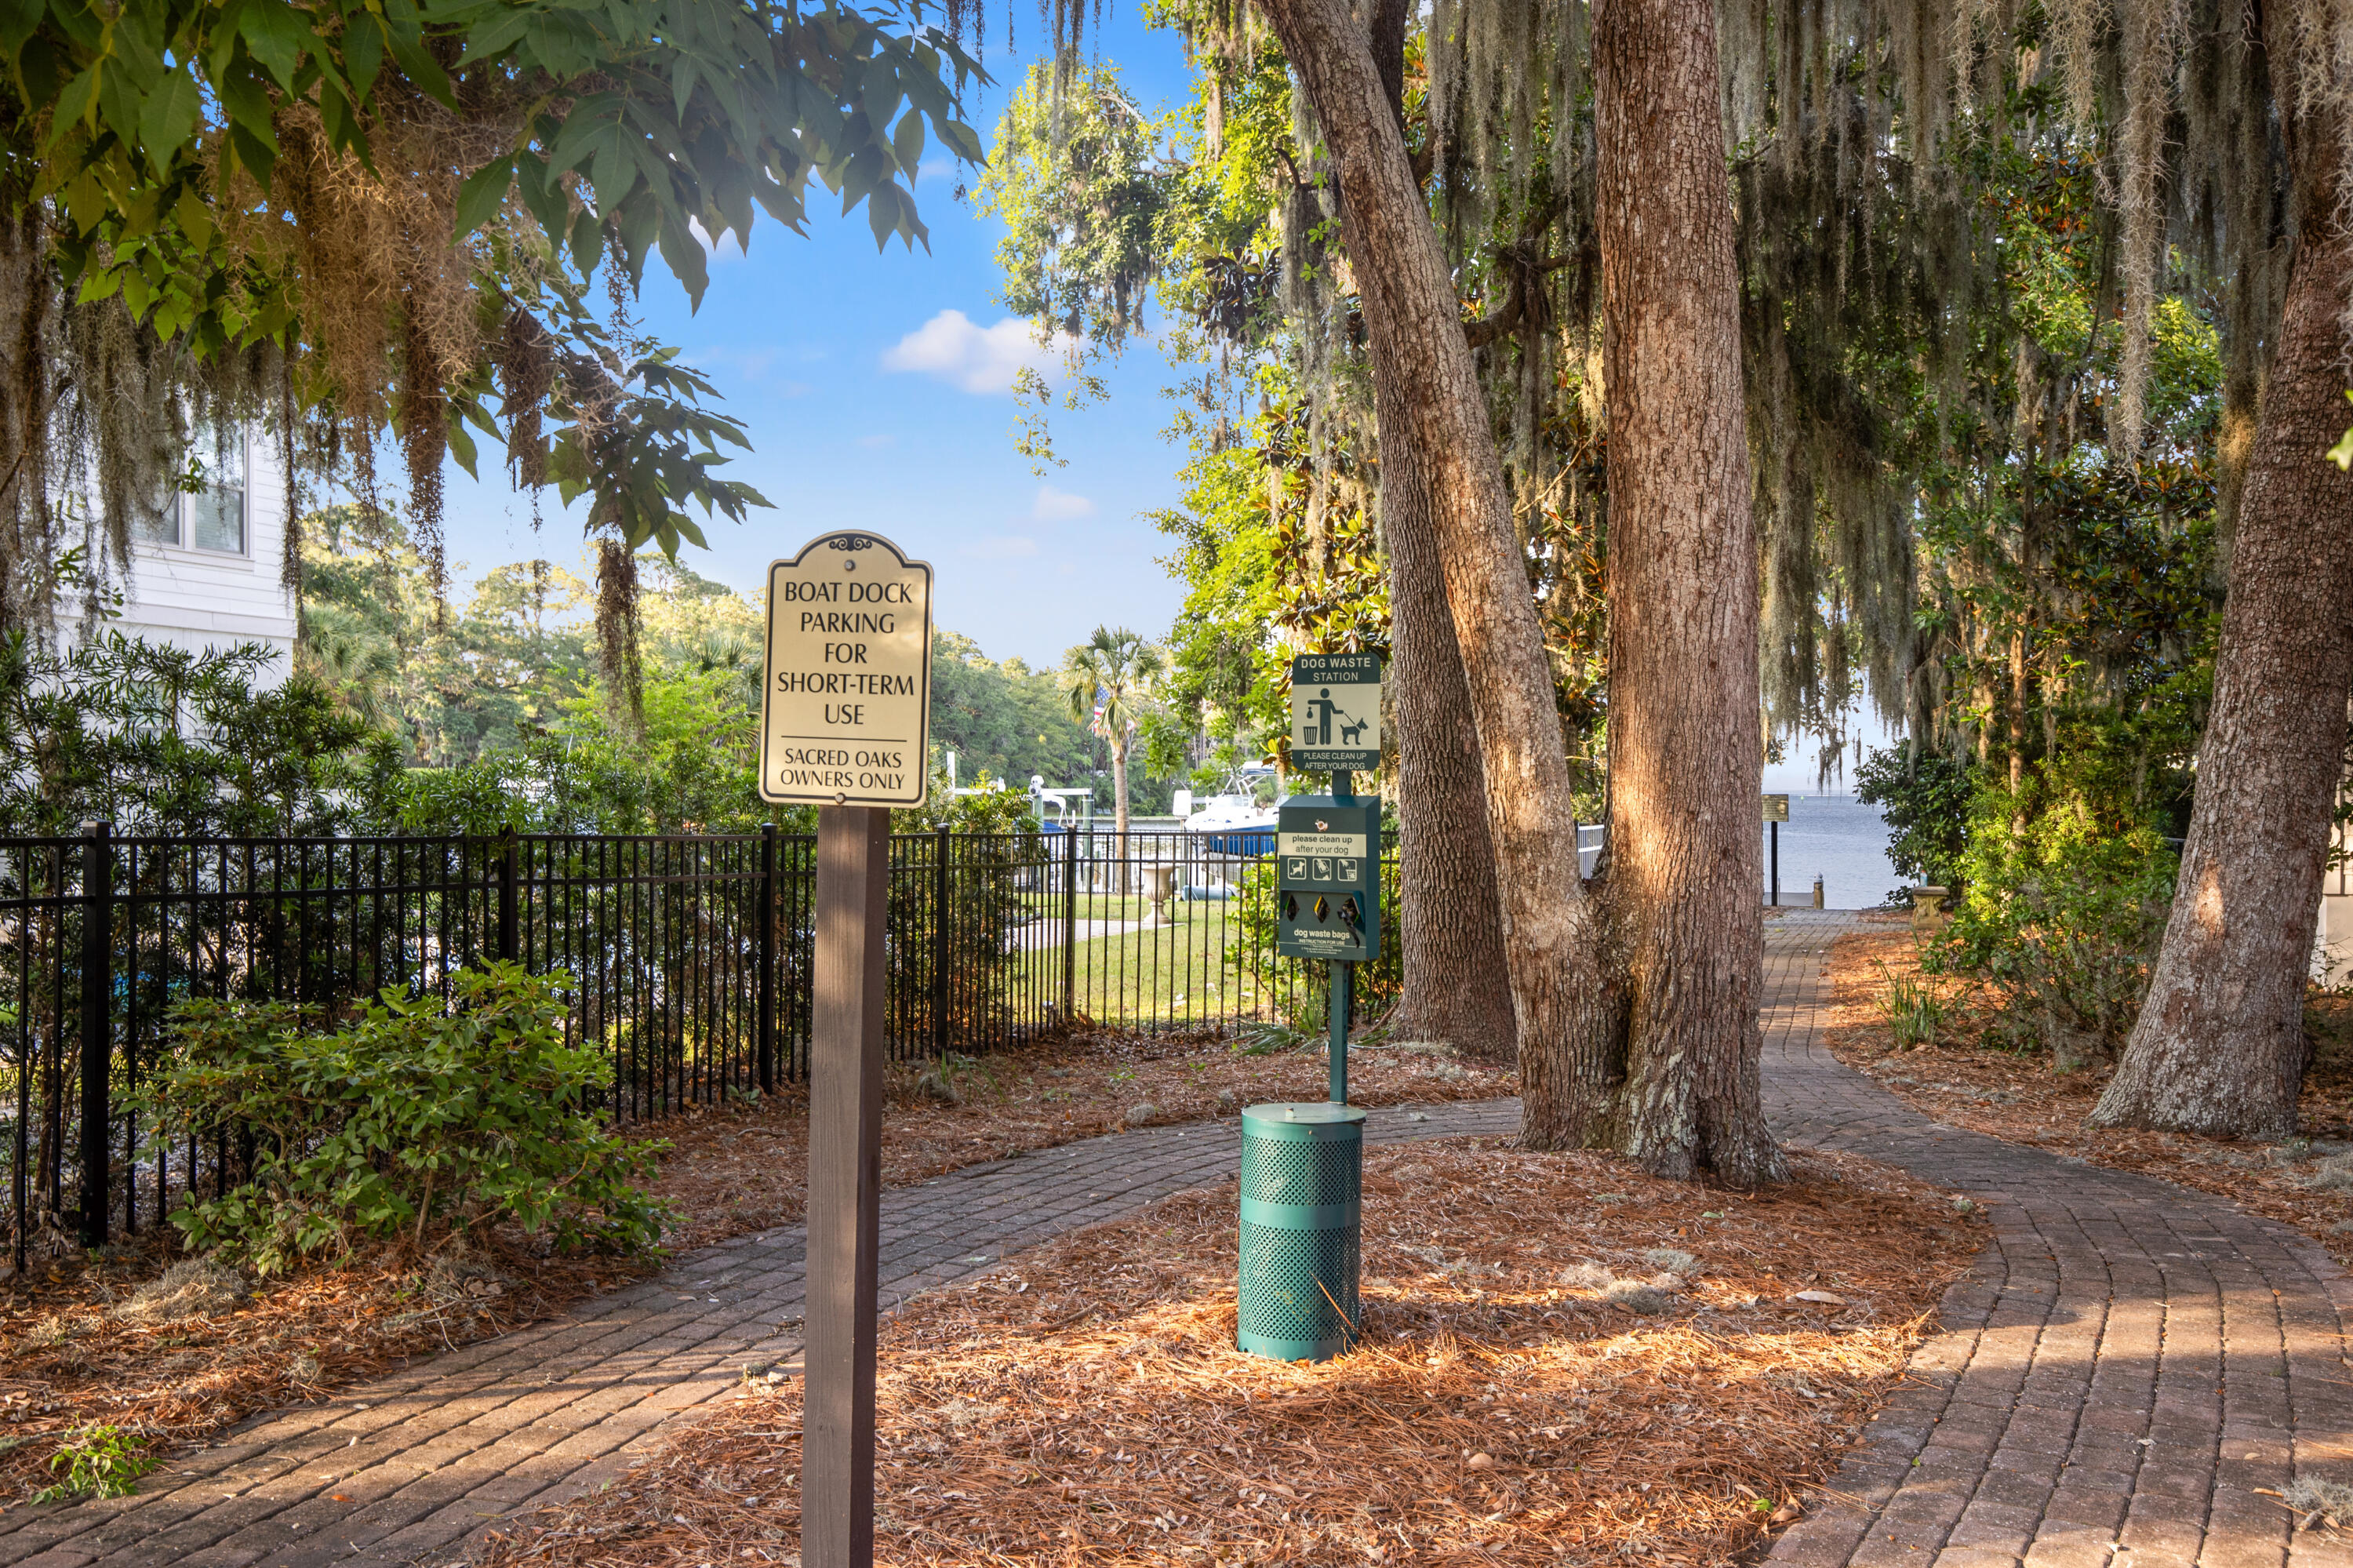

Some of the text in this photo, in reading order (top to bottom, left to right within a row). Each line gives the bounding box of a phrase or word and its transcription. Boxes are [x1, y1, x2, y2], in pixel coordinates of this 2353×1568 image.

[784, 581, 912, 603] BOAT DOCK
[800, 612, 894, 634] PARKING
[824, 642, 867, 664] FOR
[1301, 657, 1371, 668] DOG WASTE
[777, 671, 915, 696] SHORT-TERM
[1313, 671, 1358, 682] STATION
[824, 704, 864, 725] USE
[784, 748, 902, 768] SACRED OAKS
[780, 769, 905, 790] OWNERS ONLY
[1292, 835, 1318, 843] please
[1333, 846, 1349, 855] dog
[1293, 928, 1350, 940] dog waste bags
